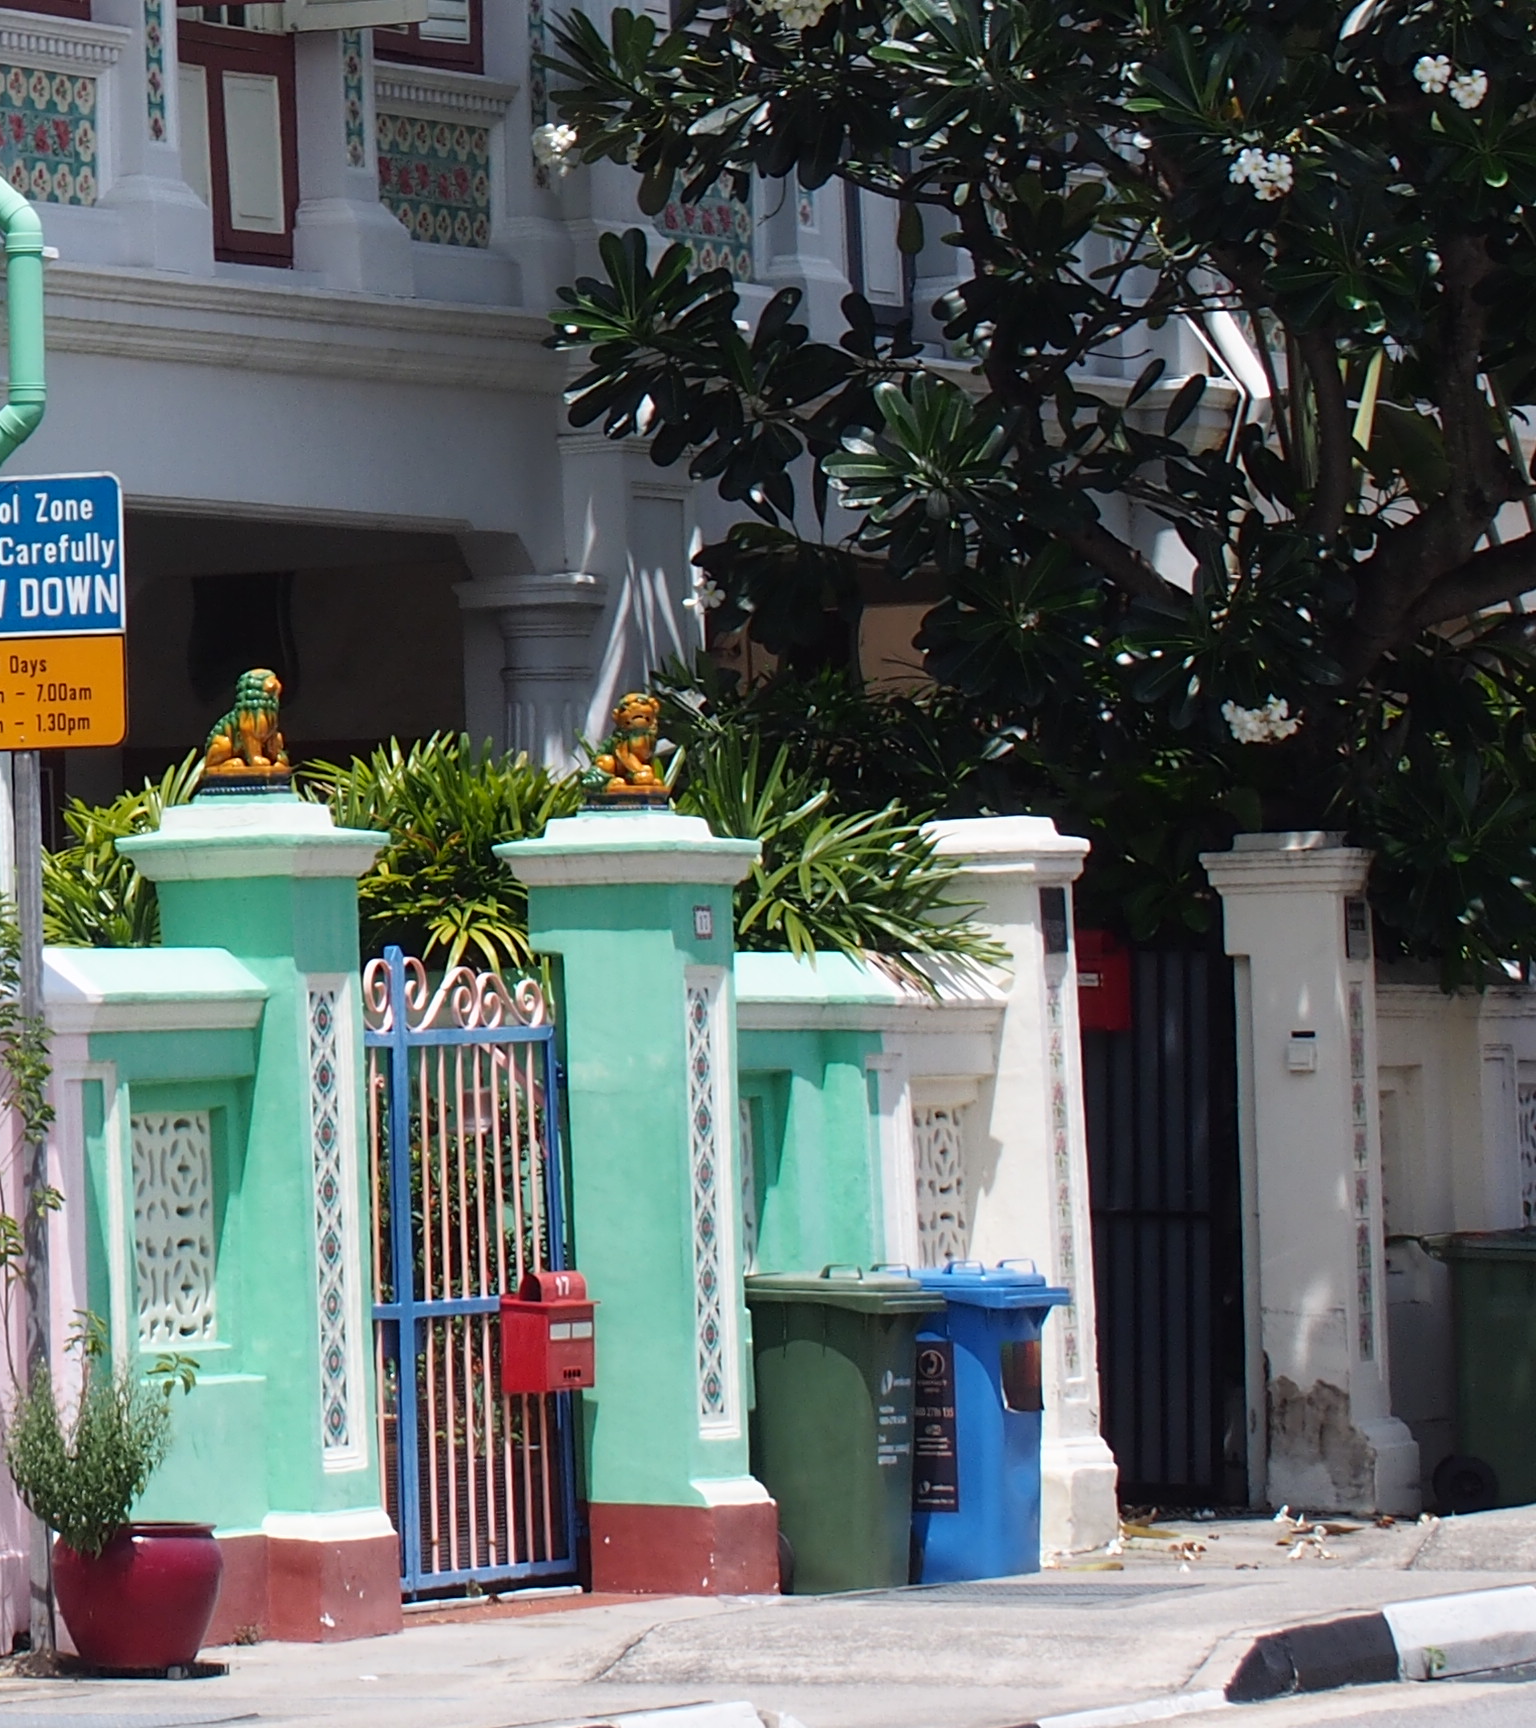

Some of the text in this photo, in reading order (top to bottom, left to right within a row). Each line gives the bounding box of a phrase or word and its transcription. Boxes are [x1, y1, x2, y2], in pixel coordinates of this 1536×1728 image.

[34, 493, 94, 523] Zone
[20, 573, 118, 618] DOWN
[9, 655, 48, 677] Days
[36, 683, 93, 703] 7.00am
[35, 713, 91, 736] 1.30pm
[555, 1275, 570, 1297] 17
